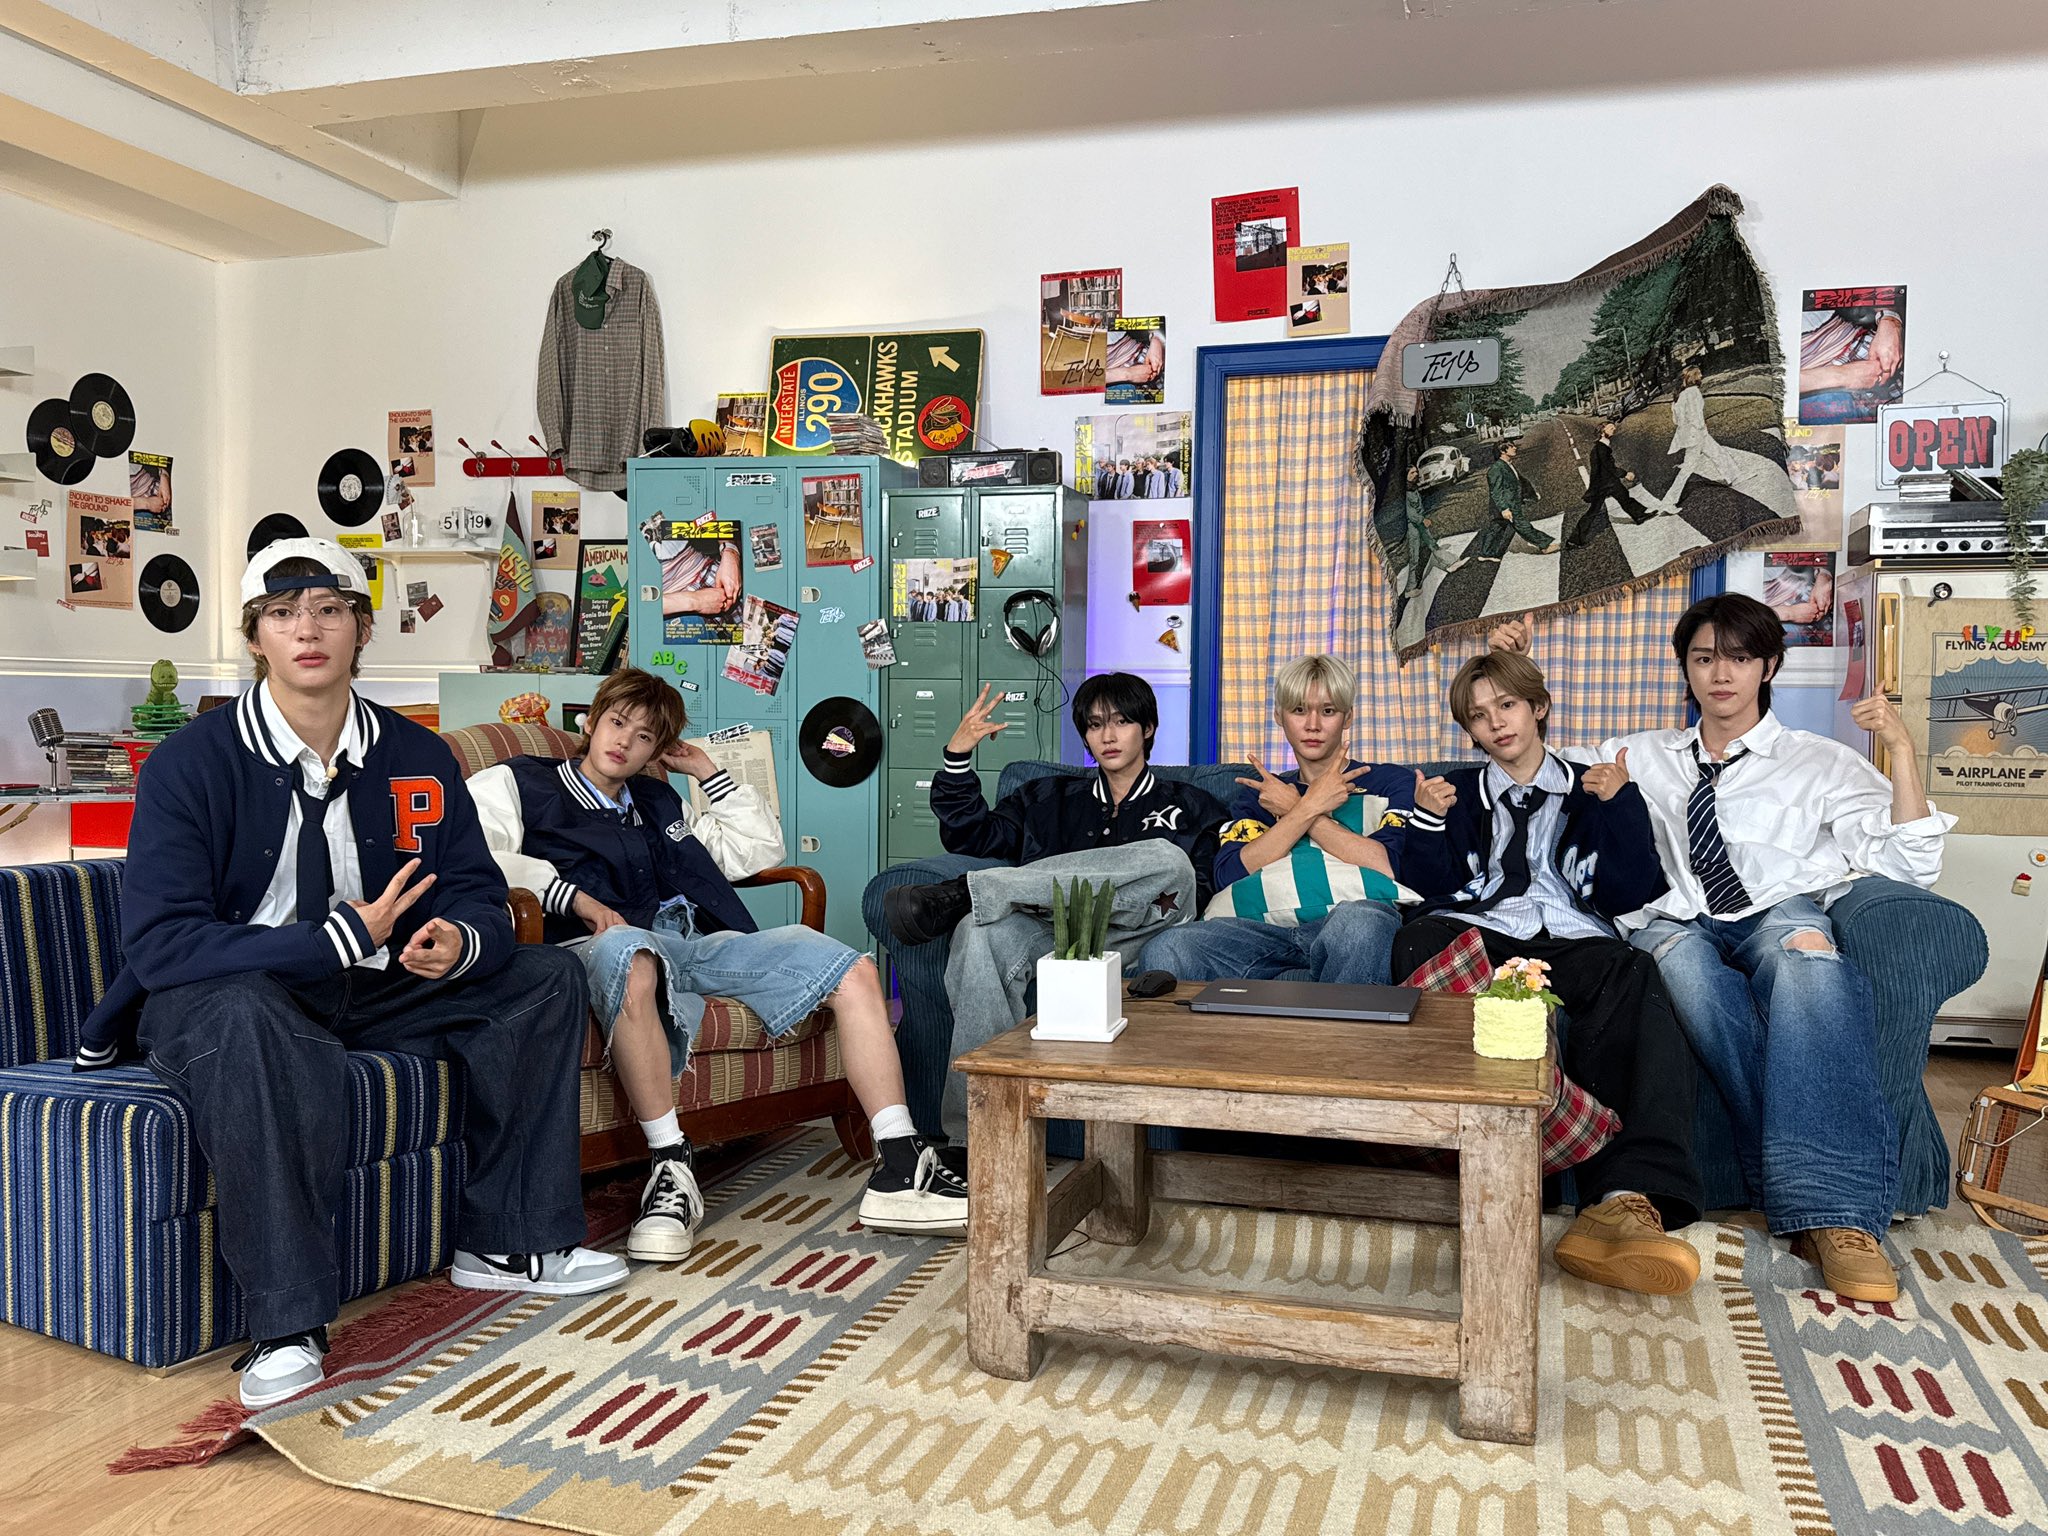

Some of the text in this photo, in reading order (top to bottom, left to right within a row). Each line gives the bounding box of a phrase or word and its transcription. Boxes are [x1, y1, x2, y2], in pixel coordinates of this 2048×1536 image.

[805, 372, 844, 433] 290
[872, 341, 899, 449] ACKHAWKS
[779, 370, 796, 438] INTERSTATE
[798, 388, 807, 421] ILLINOIS
[894, 370, 919, 466] STADIUM
[1889, 416, 1996, 472] OPEN
[69, 492, 93, 501] ENOUGH
[104, 496, 132, 507] SHAKE
[69, 500, 108, 512] THE GROUND
[696, 512, 714, 526] RIIZE
[918, 508, 938, 518] RIIZE
[444, 515, 484, 529] 5 19
[584, 548, 619, 568] AMERICAN
[853, 557, 872, 572] RIIZE
[2004, 624, 2035, 646] UP
[1946, 641, 2047, 651] FLYING ACADEMY
[682, 681, 698, 691] RIIZE
[1006, 692, 1026, 702] RIIZE
[1956, 767, 2026, 779] AIRPLANE
[389, 776, 444, 853] P
[1141, 805, 1183, 831] NY
